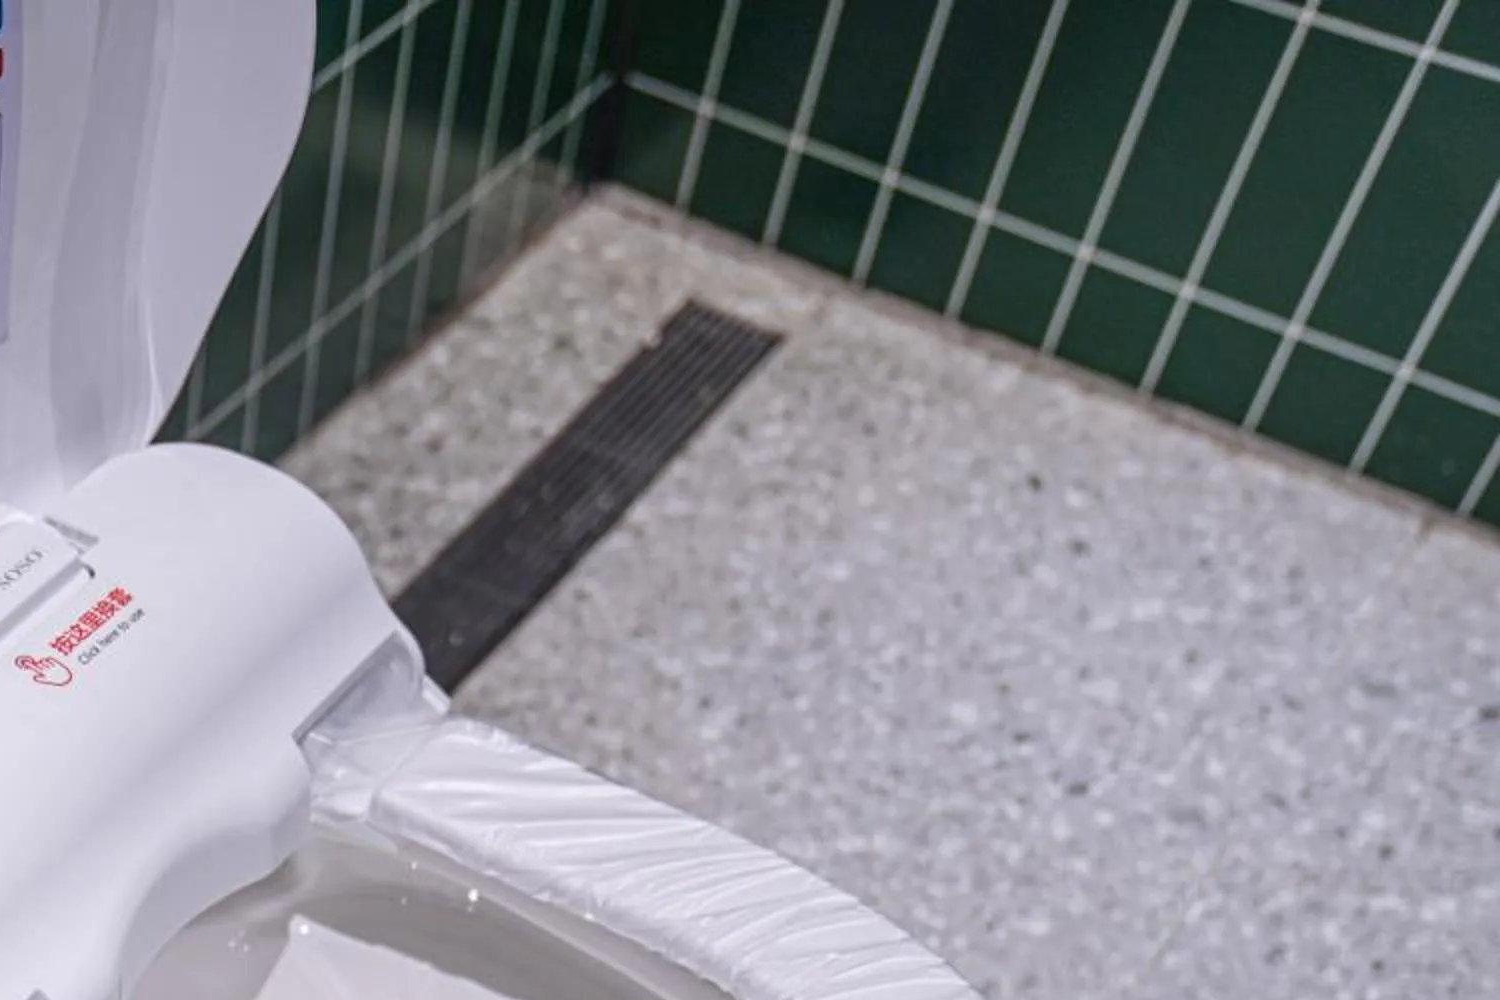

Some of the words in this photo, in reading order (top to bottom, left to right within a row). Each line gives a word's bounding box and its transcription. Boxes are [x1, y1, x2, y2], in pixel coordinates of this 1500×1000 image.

[49, 587, 132, 656] 按这里换套
[78, 644, 100, 665] Click
